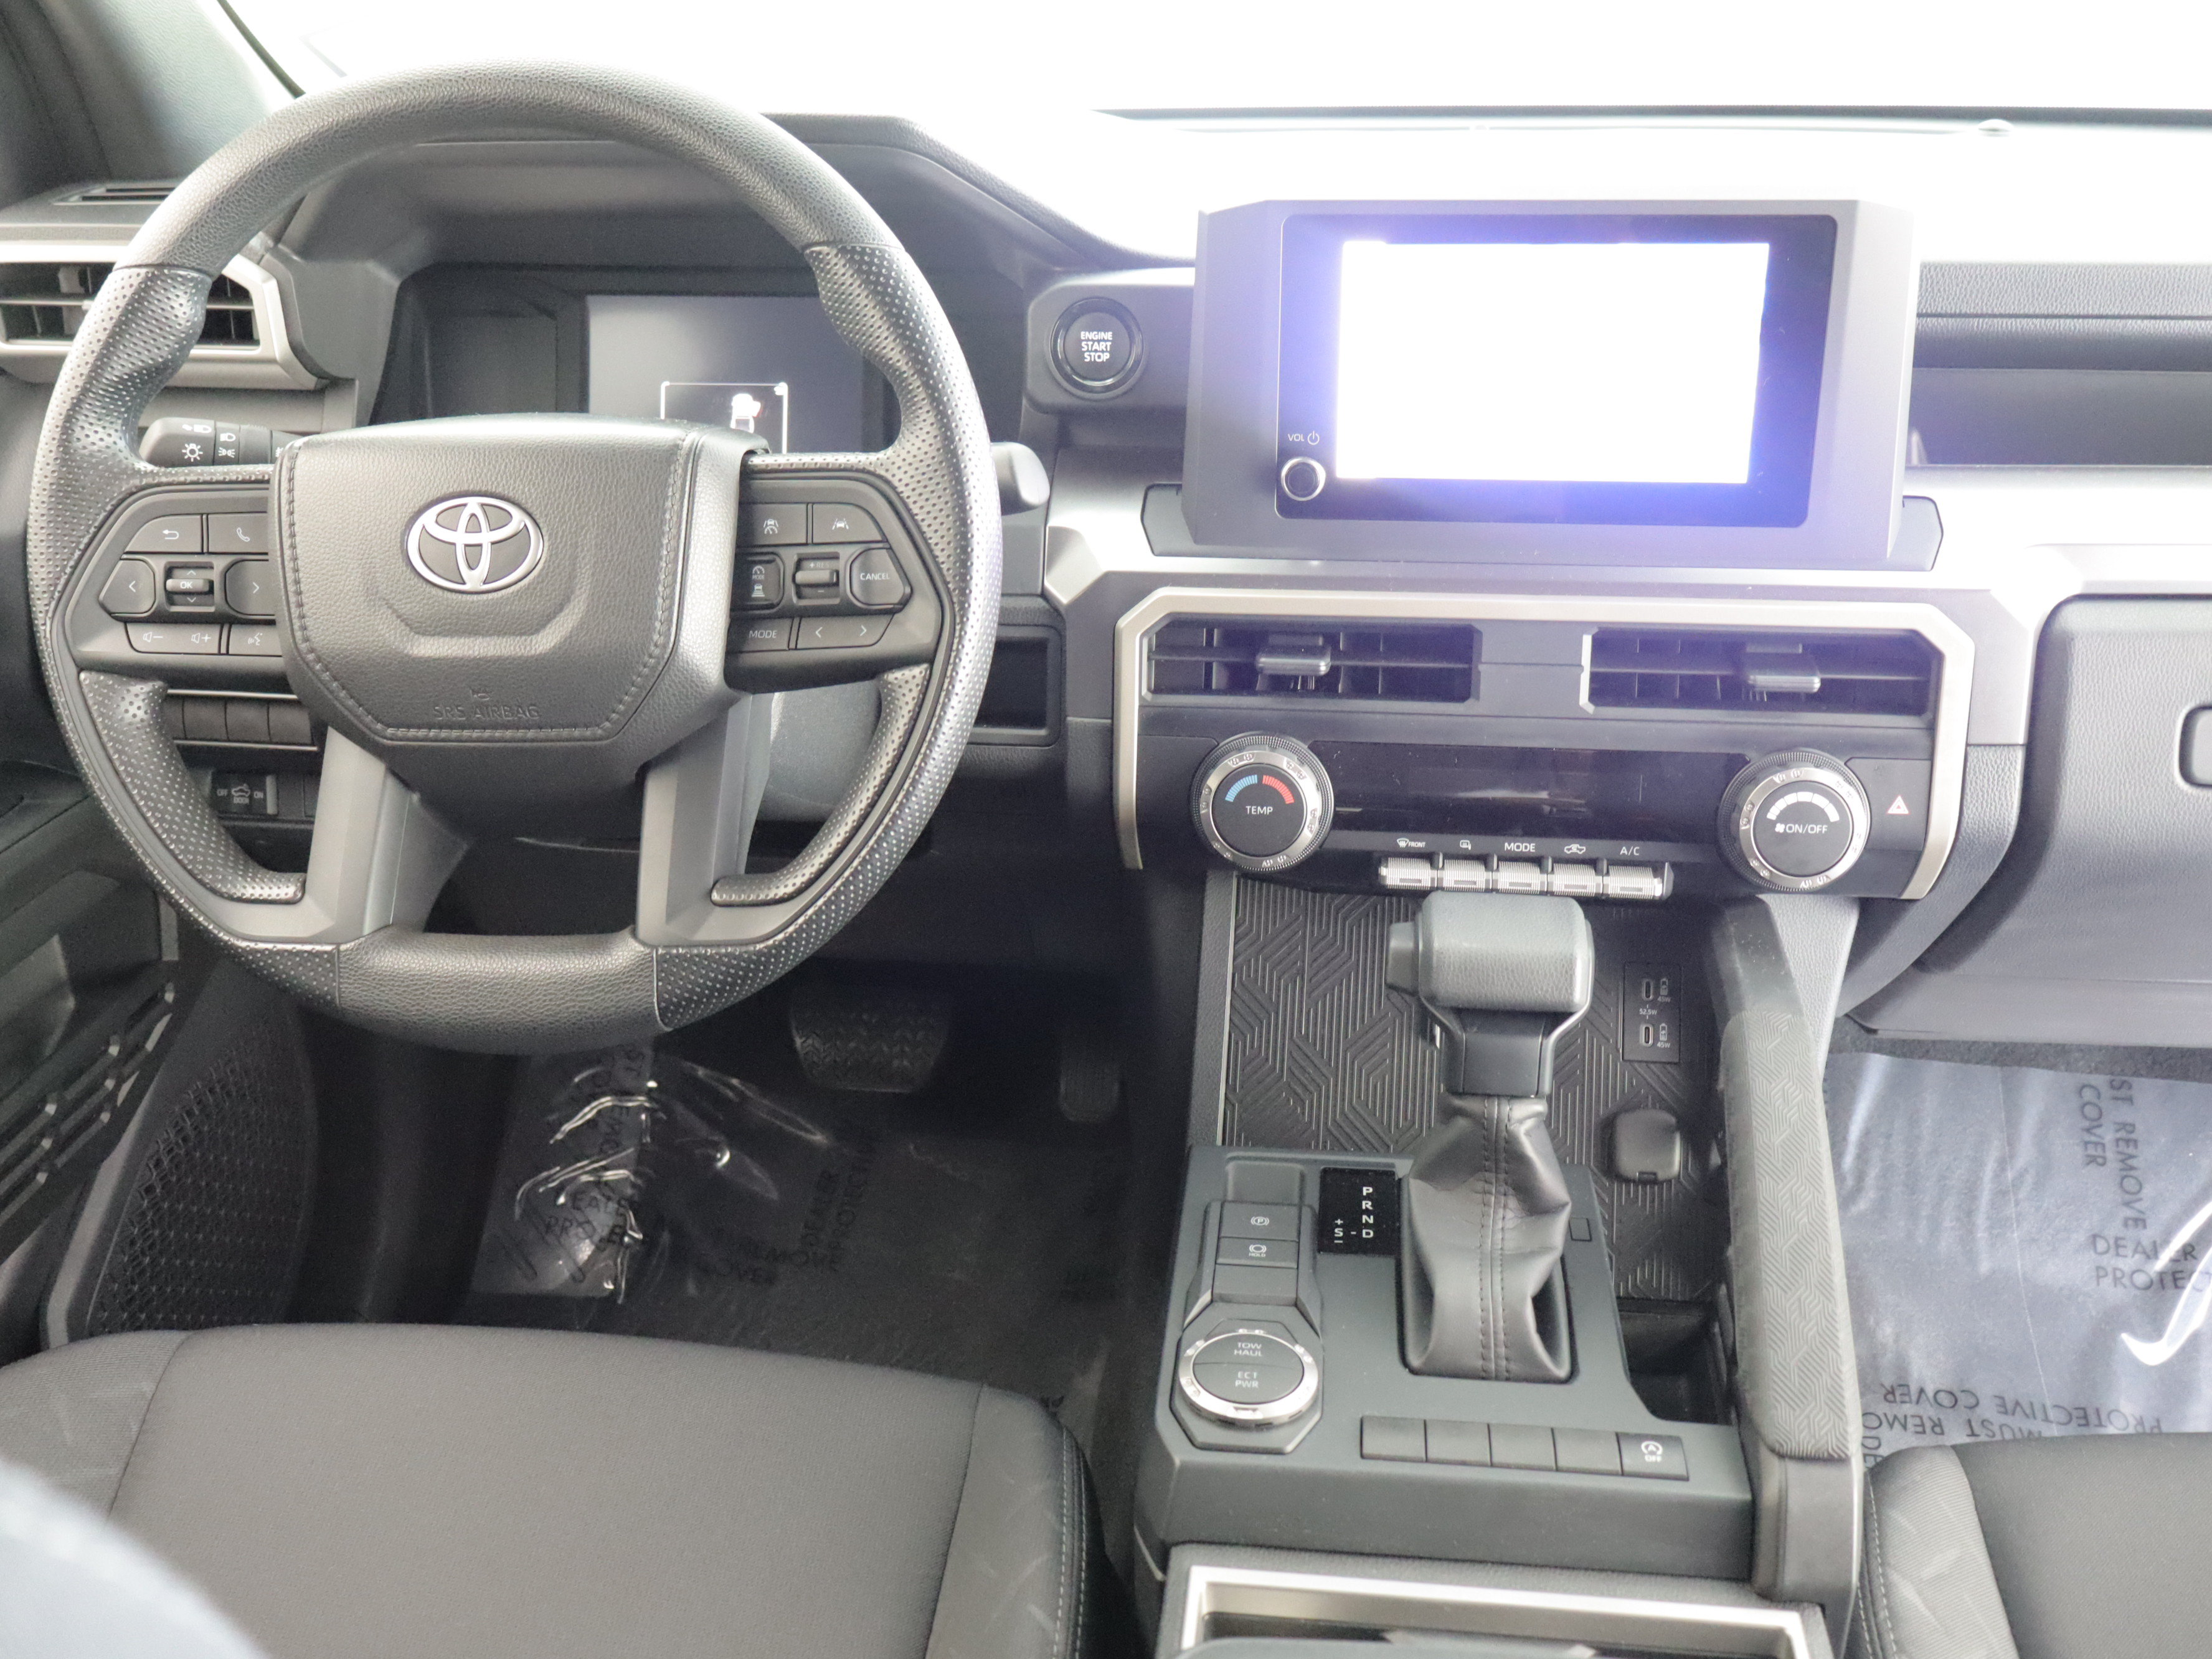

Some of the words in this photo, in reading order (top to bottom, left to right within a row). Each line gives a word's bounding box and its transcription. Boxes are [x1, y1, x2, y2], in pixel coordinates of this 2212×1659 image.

[1080, 331, 1113, 340] ENGINE
[1081, 341, 1112, 351] START
[1084, 352, 1110, 362] STOP
[1287, 433, 1305, 442] VOL
[860, 572, 891, 581] CANCEL
[180, 581, 193, 589] OK
[749, 630, 778, 639] MODE
[433, 704, 466, 720] SRS
[471, 703, 543, 720] AIRBAG
[1245, 805, 1274, 815] TEMP
[1785, 823, 1828, 834] ON/OFF
[1504, 842, 1536, 853] MODE
[1620, 846, 1640, 856] A/C
[2078, 1084, 2107, 1168] COVER
[2113, 1121, 2148, 1230] REMOVE
[1363, 1186, 1373, 1196] P
[1362, 1200, 1373, 1210] R
[1362, 1214, 1374, 1224] N
[1334, 1227, 1343, 1237] S
[1362, 1229, 1374, 1239] D
[2091, 1233, 2198, 1263] DEALR
[1234, 1349, 1262, 1357] HAUL
[1237, 1371, 1257, 1379] ECT
[1235, 1379, 1259, 1388] PWR
[1879, 1382, 1980, 1409] COVER
[1993, 1394, 2163, 1433] PROTECTIVE
[1861, 1412, 1945, 1436] REMO
[1645, 1454, 1662, 1463] OFF
